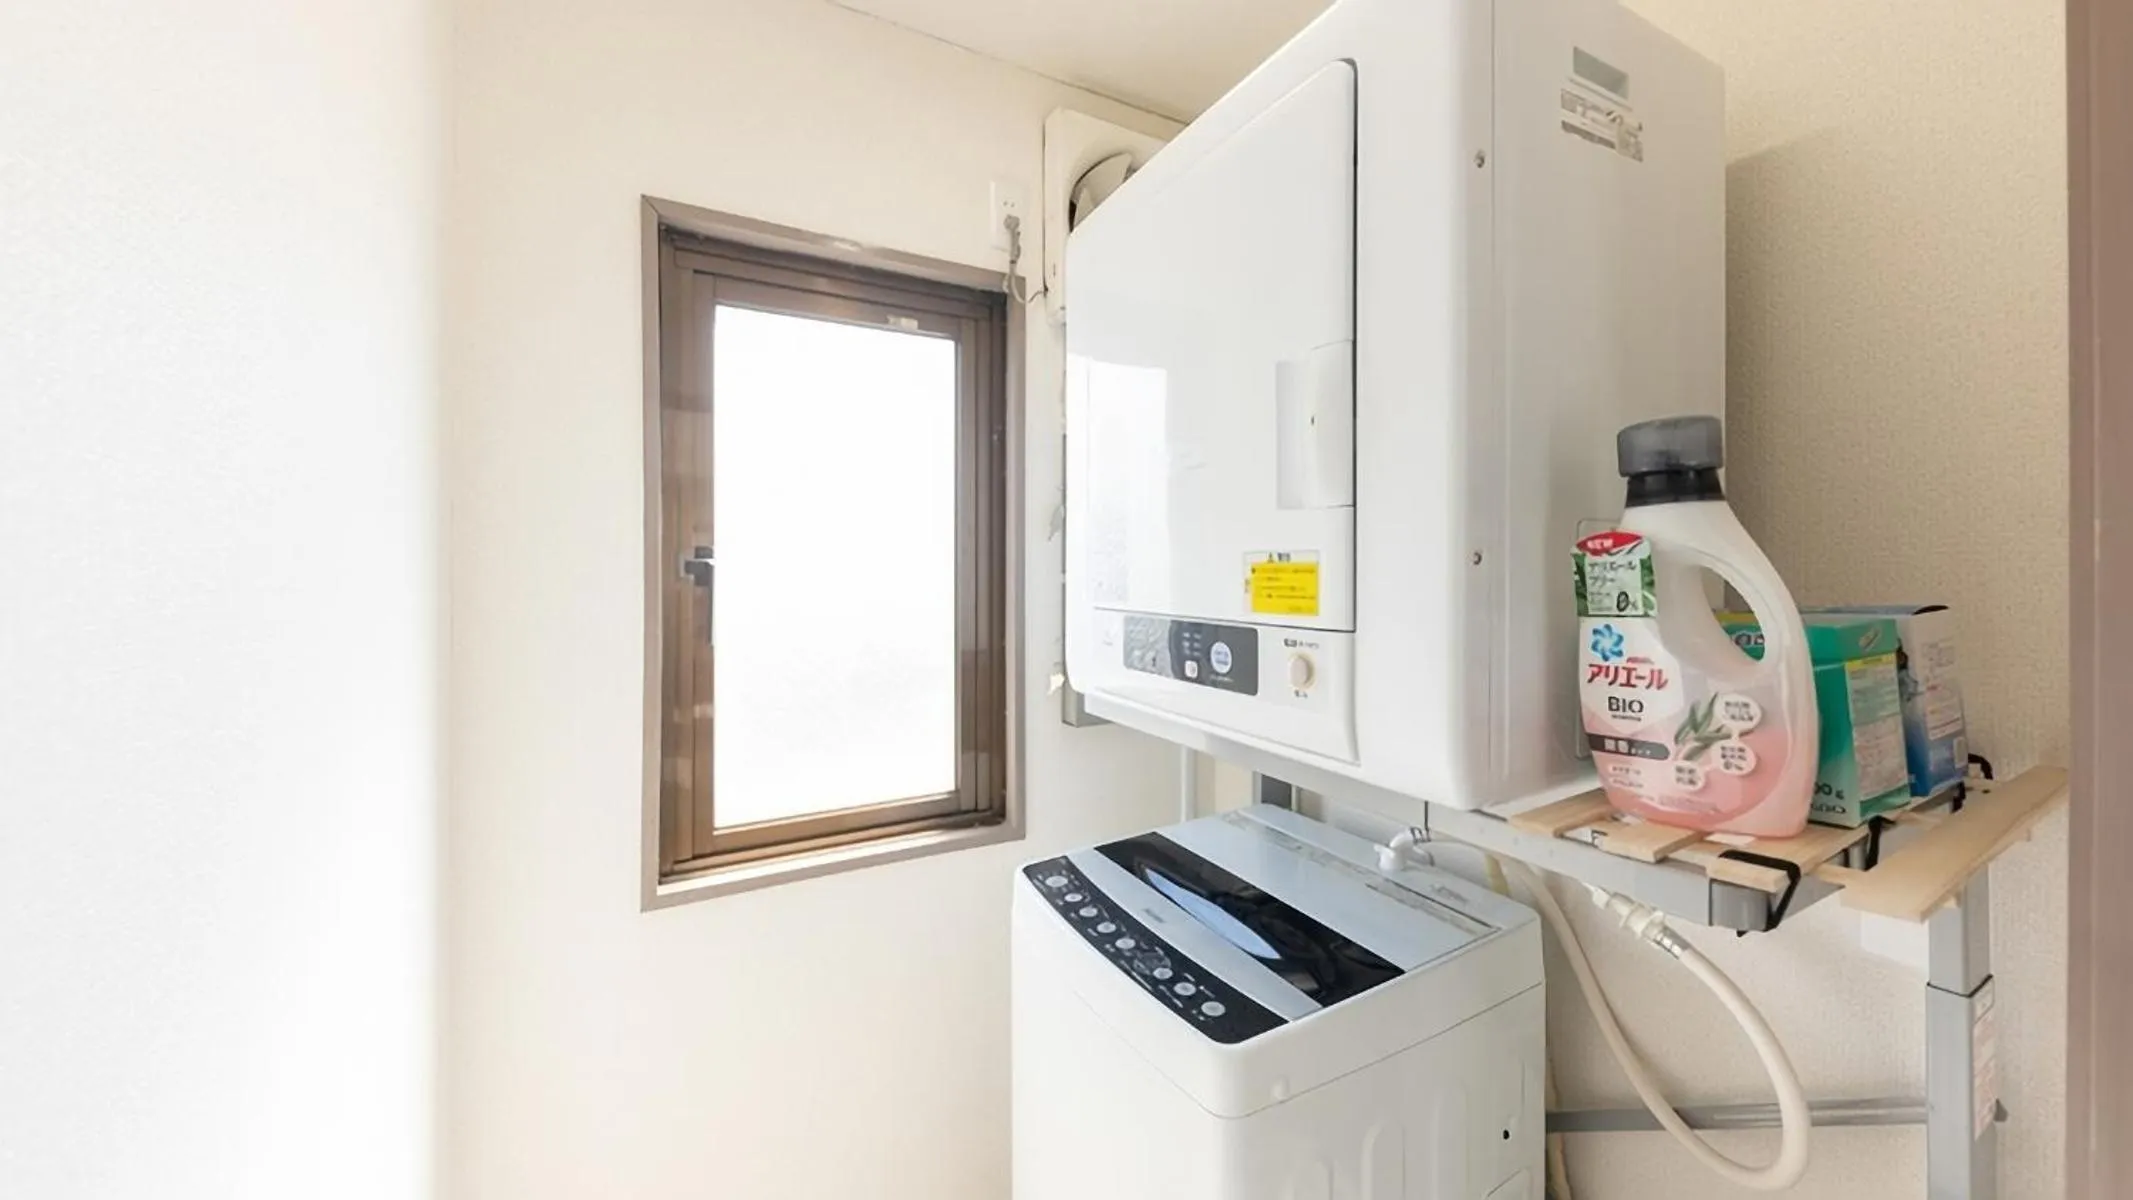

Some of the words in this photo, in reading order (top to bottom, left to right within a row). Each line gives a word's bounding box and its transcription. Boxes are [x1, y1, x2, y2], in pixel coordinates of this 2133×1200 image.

[1586, 664, 1669, 690] アリエール
[1607, 696, 1644, 713] BIO
